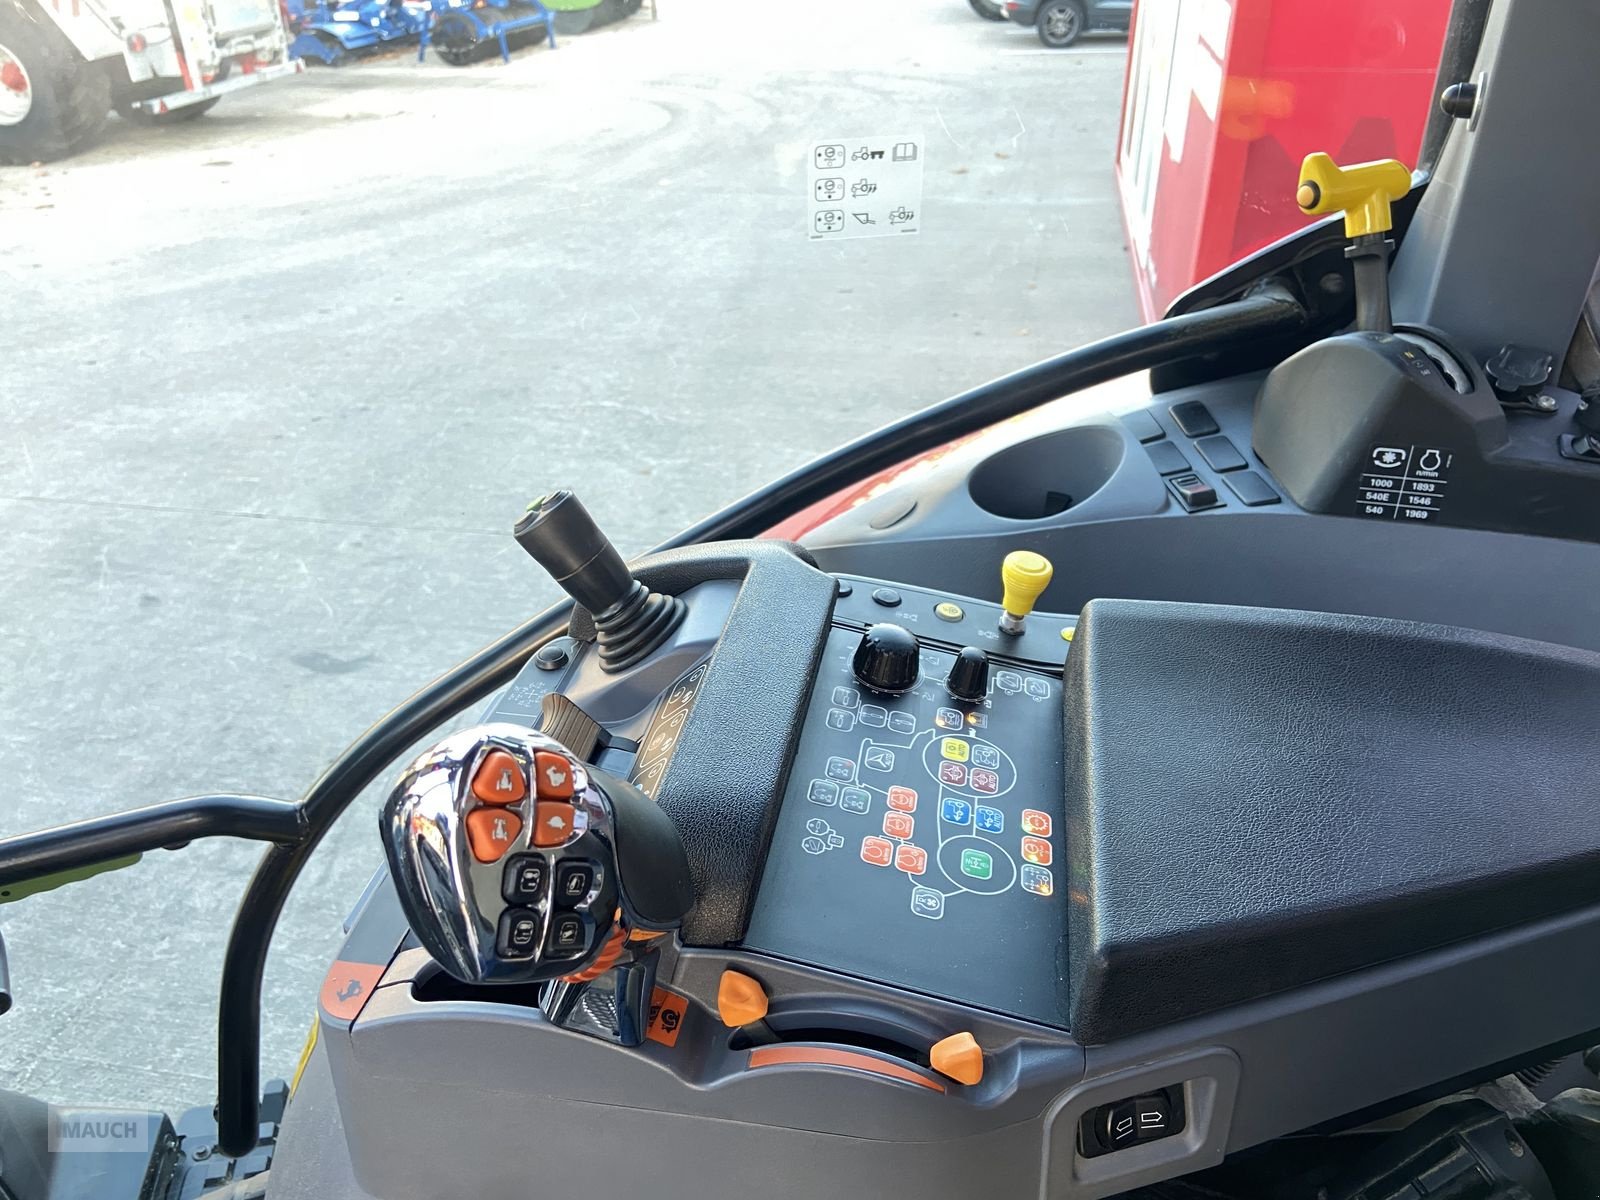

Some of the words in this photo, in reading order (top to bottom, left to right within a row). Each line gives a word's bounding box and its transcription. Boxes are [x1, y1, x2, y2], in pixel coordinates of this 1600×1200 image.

[1370, 478, 1393, 488] 1000
[1412, 482, 1435, 492] 1893
[1365, 491, 1390, 502] 540E
[1408, 495, 1431, 506] 1546
[1365, 505, 1383, 514] 540
[1405, 509, 1428, 519] 1969
